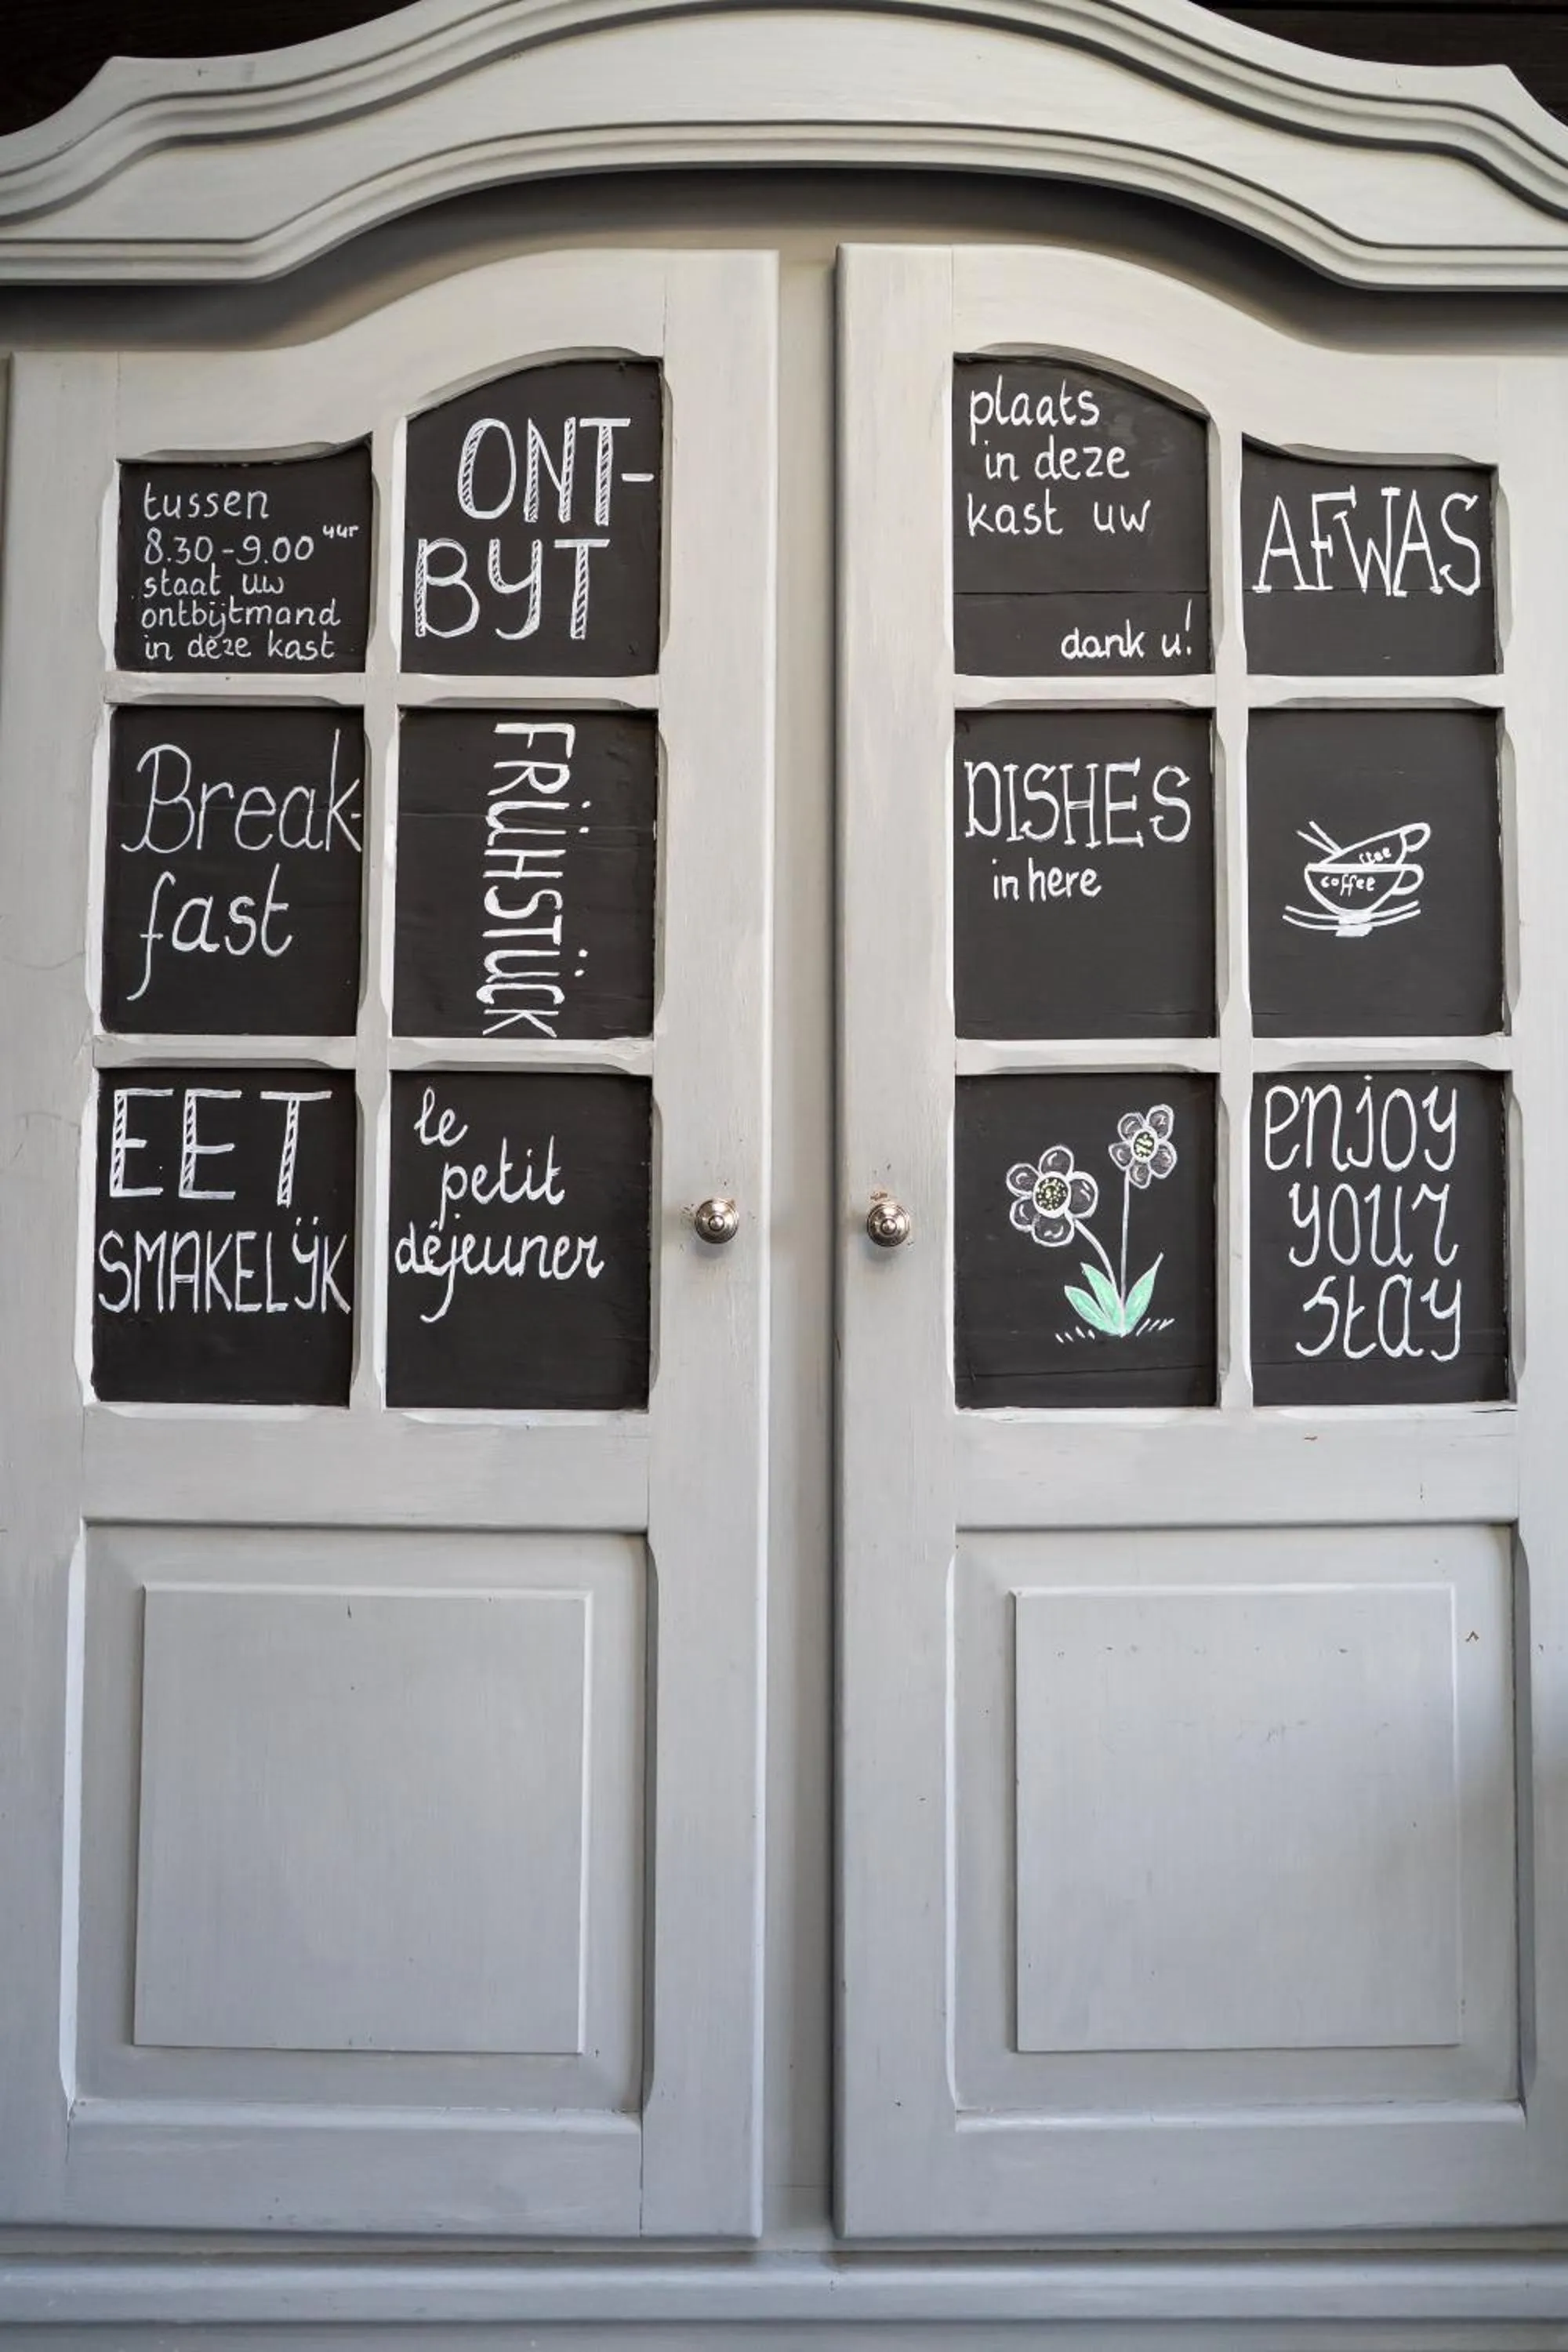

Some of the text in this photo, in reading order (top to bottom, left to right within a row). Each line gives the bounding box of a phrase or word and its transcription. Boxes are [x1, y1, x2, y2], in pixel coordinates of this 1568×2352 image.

[969, 374, 1100, 446] plaats
[457, 416, 655, 527] ONT-
[984, 434, 1131, 483] in deze
[143, 482, 269, 521] tussen
[322, 524, 359, 539] uur
[967, 488, 1152, 537] kast uw
[143, 561, 285, 598] staat uw
[1250, 485, 1481, 598] AFWAS
[141, 593, 341, 641] ontbijtmand
[413, 538, 611, 641] BYT
[145, 629, 335, 662] in deze kast
[1061, 599, 1192, 660] dank u!
[121, 728, 361, 854] Break-
[964, 757, 1192, 850] DISHES
[476, 722, 591, 1038] FRÜHSTÜCK
[992, 857, 1102, 902] in here
[1320, 873, 1375, 897] coffee
[126, 862, 292, 1001] fast
[109, 1087, 332, 1208] EET
[413, 1087, 469, 1147] le
[1265, 1074, 1457, 1173] enjoy
[437, 1133, 565, 1232] petit
[1288, 1181, 1459, 1268] your
[394, 1210, 605, 1323] déjeuner
